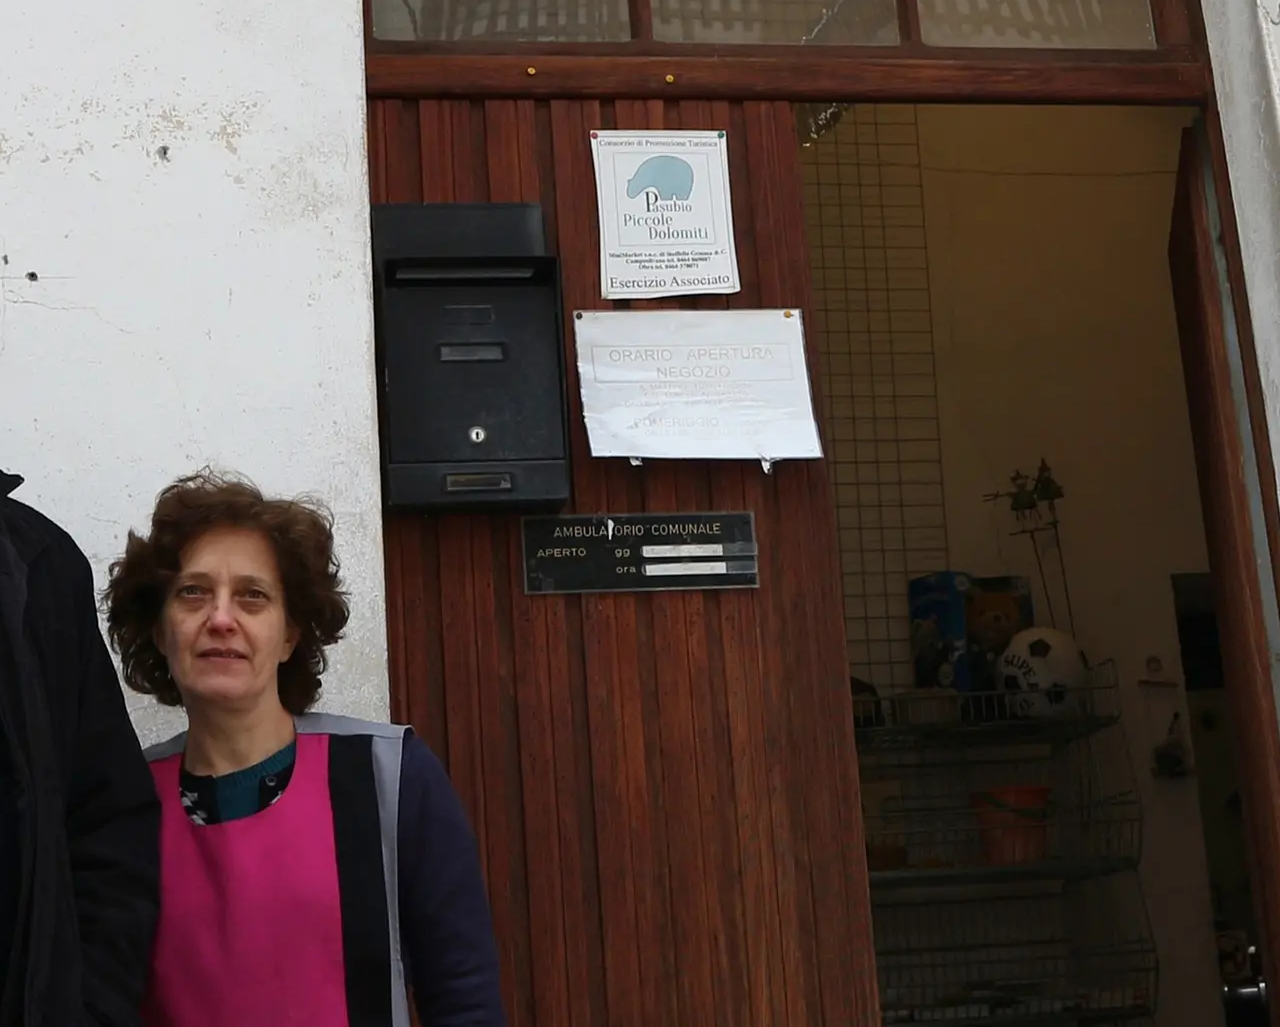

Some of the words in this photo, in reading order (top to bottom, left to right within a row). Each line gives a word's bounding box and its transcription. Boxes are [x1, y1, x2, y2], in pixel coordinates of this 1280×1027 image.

[645, 139, 687, 147] Promozione
[644, 190, 693, 213] Pasubio
[623, 213, 673, 227] Piccole
[648, 226, 708, 240] Dolomiti
[609, 276, 667, 289] Esercizio
[669, 274, 730, 288] Associato
[608, 349, 673, 363] ORARIO
[686, 347, 775, 361] APERTURA
[656, 365, 731, 379] NEGOZIO
[553, 524, 644, 538] AMBULAORIO
[651, 523, 721, 536] COMUNALE
[537, 548, 587, 558] APERTO
[614, 549, 631, 558] gg
[616, 565, 637, 573] ora
